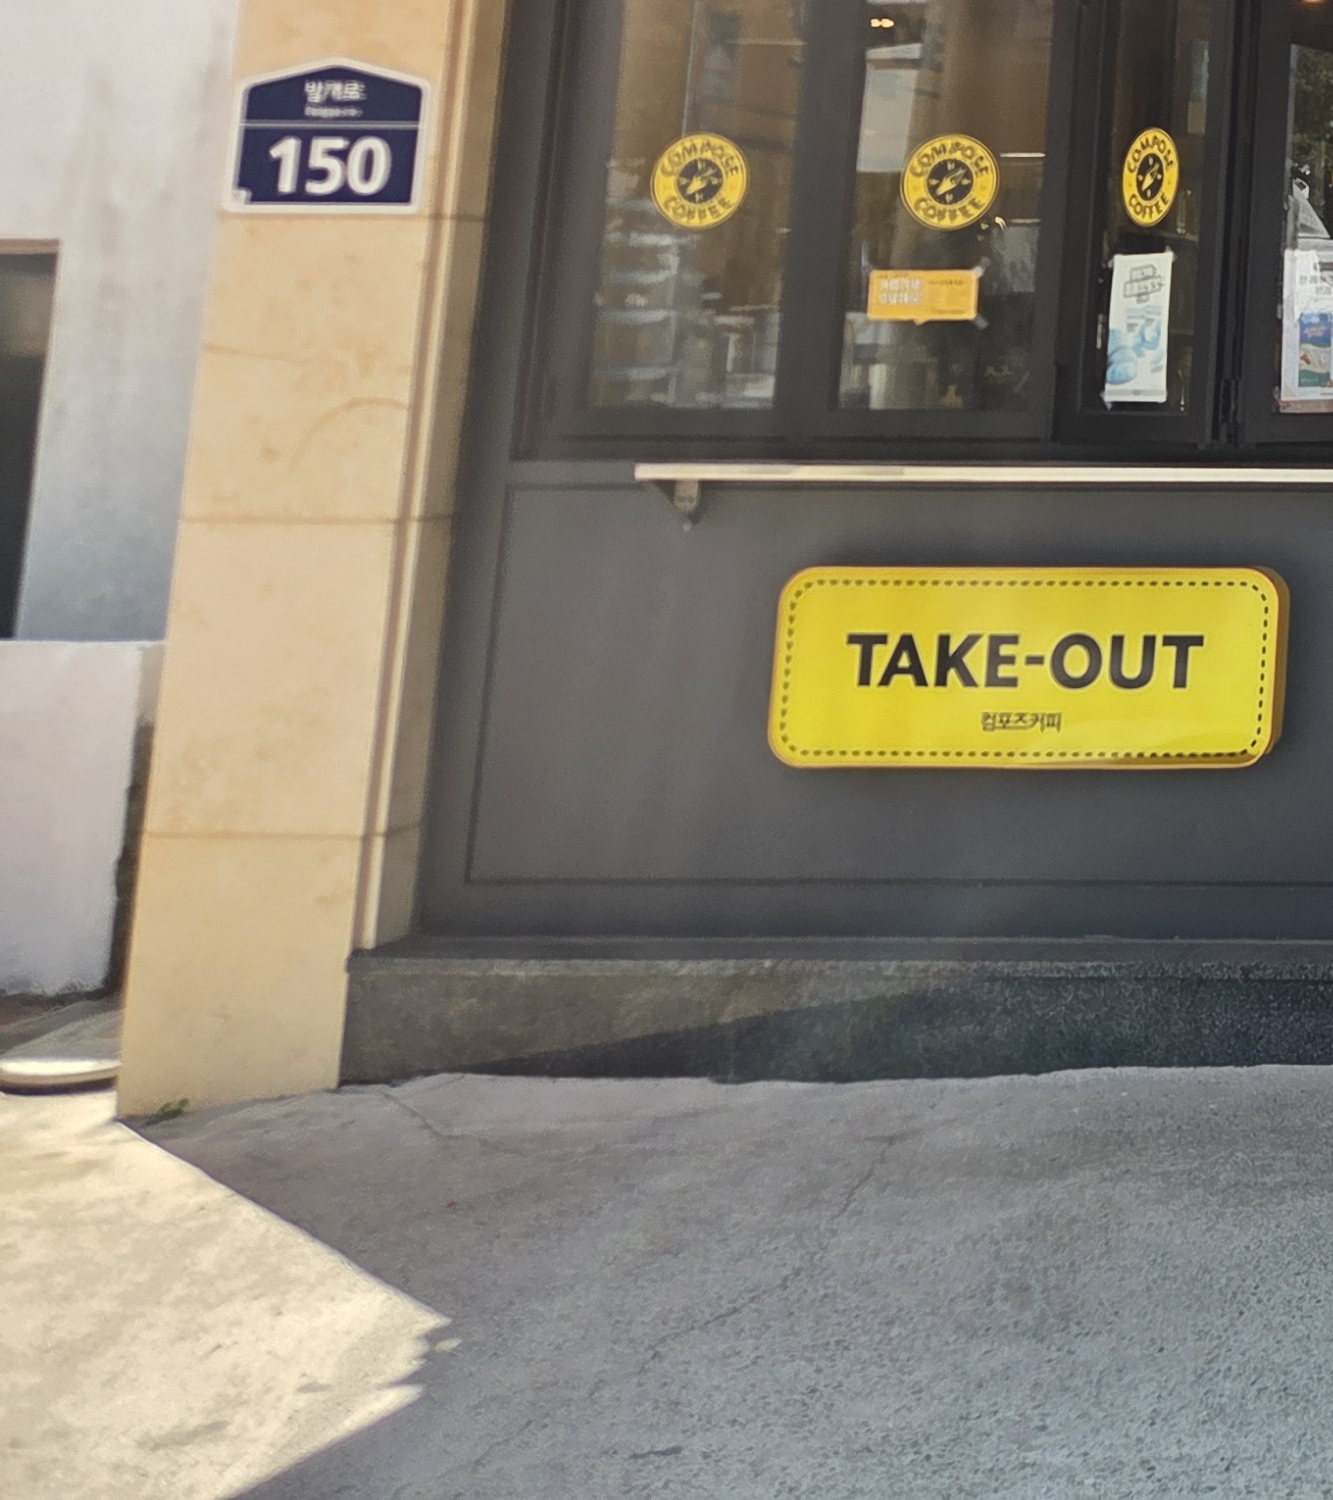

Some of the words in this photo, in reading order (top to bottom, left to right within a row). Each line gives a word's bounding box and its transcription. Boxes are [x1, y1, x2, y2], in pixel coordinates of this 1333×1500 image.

[268, 135, 392, 196] 150
[846, 632, 1204, 690] TAKE-OUT
[980, 711, 1062, 733] 컴포즈커피
